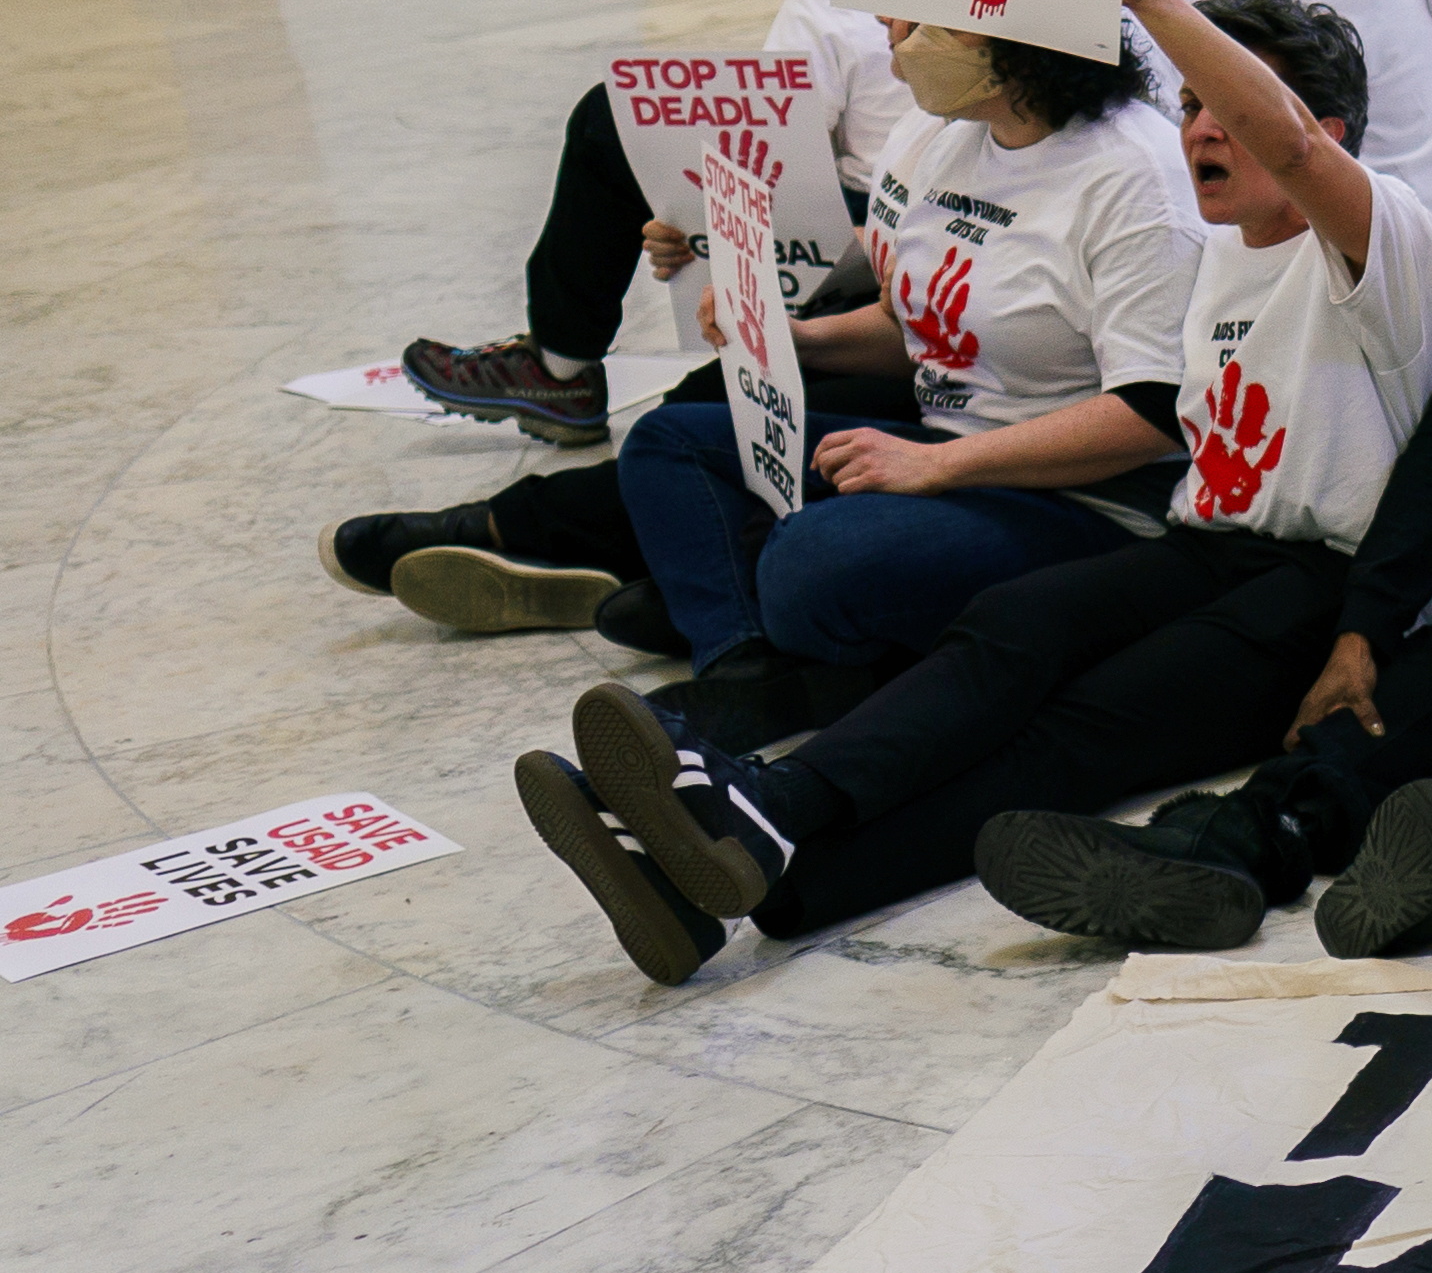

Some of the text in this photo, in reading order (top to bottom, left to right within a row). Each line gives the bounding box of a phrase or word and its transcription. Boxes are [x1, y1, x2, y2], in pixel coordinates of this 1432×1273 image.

[611, 58, 814, 90] STOP THE
[631, 96, 795, 127] DEADLY
[705, 154, 771, 229] STOP THE
[688, 233, 835, 268] GBAL
[710, 197, 764, 264] DEADLY
[945, 218, 977, 239] CUTS
[1210, 321, 1235, 342] AIDS
[738, 365, 797, 434] GLOBAL
[765, 415, 787, 459] AID
[752, 440, 795, 510] FREEZE
[267, 817, 375, 873] USAID
[322, 801, 430, 852] SAVE
[139, 850, 259, 908] LIVES
[206, 835, 318, 891] SAVE
